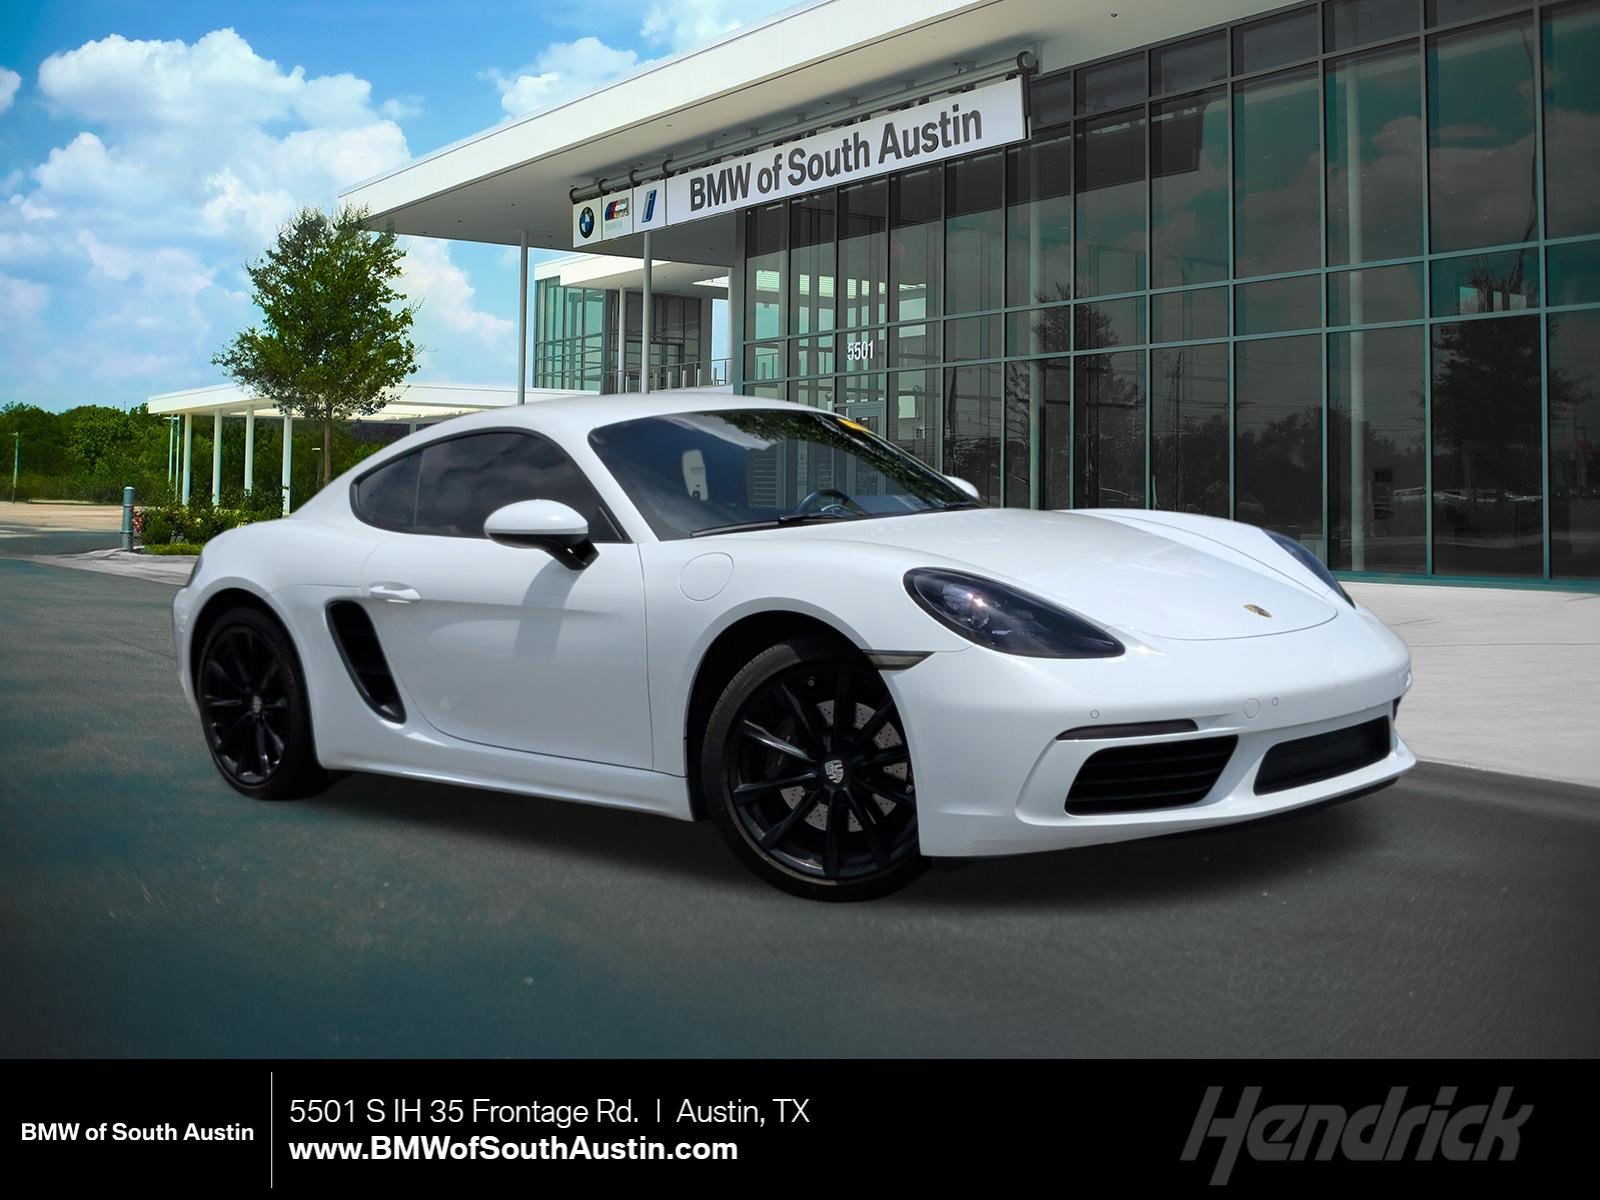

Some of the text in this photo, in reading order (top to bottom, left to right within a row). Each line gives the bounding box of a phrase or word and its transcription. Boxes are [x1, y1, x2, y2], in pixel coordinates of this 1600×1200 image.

[690, 162, 751, 212] BMW
[757, 153, 783, 194] of
[787, 132, 870, 186] South
[878, 104, 982, 164] Austin
[847, 340, 874, 361] 5501
